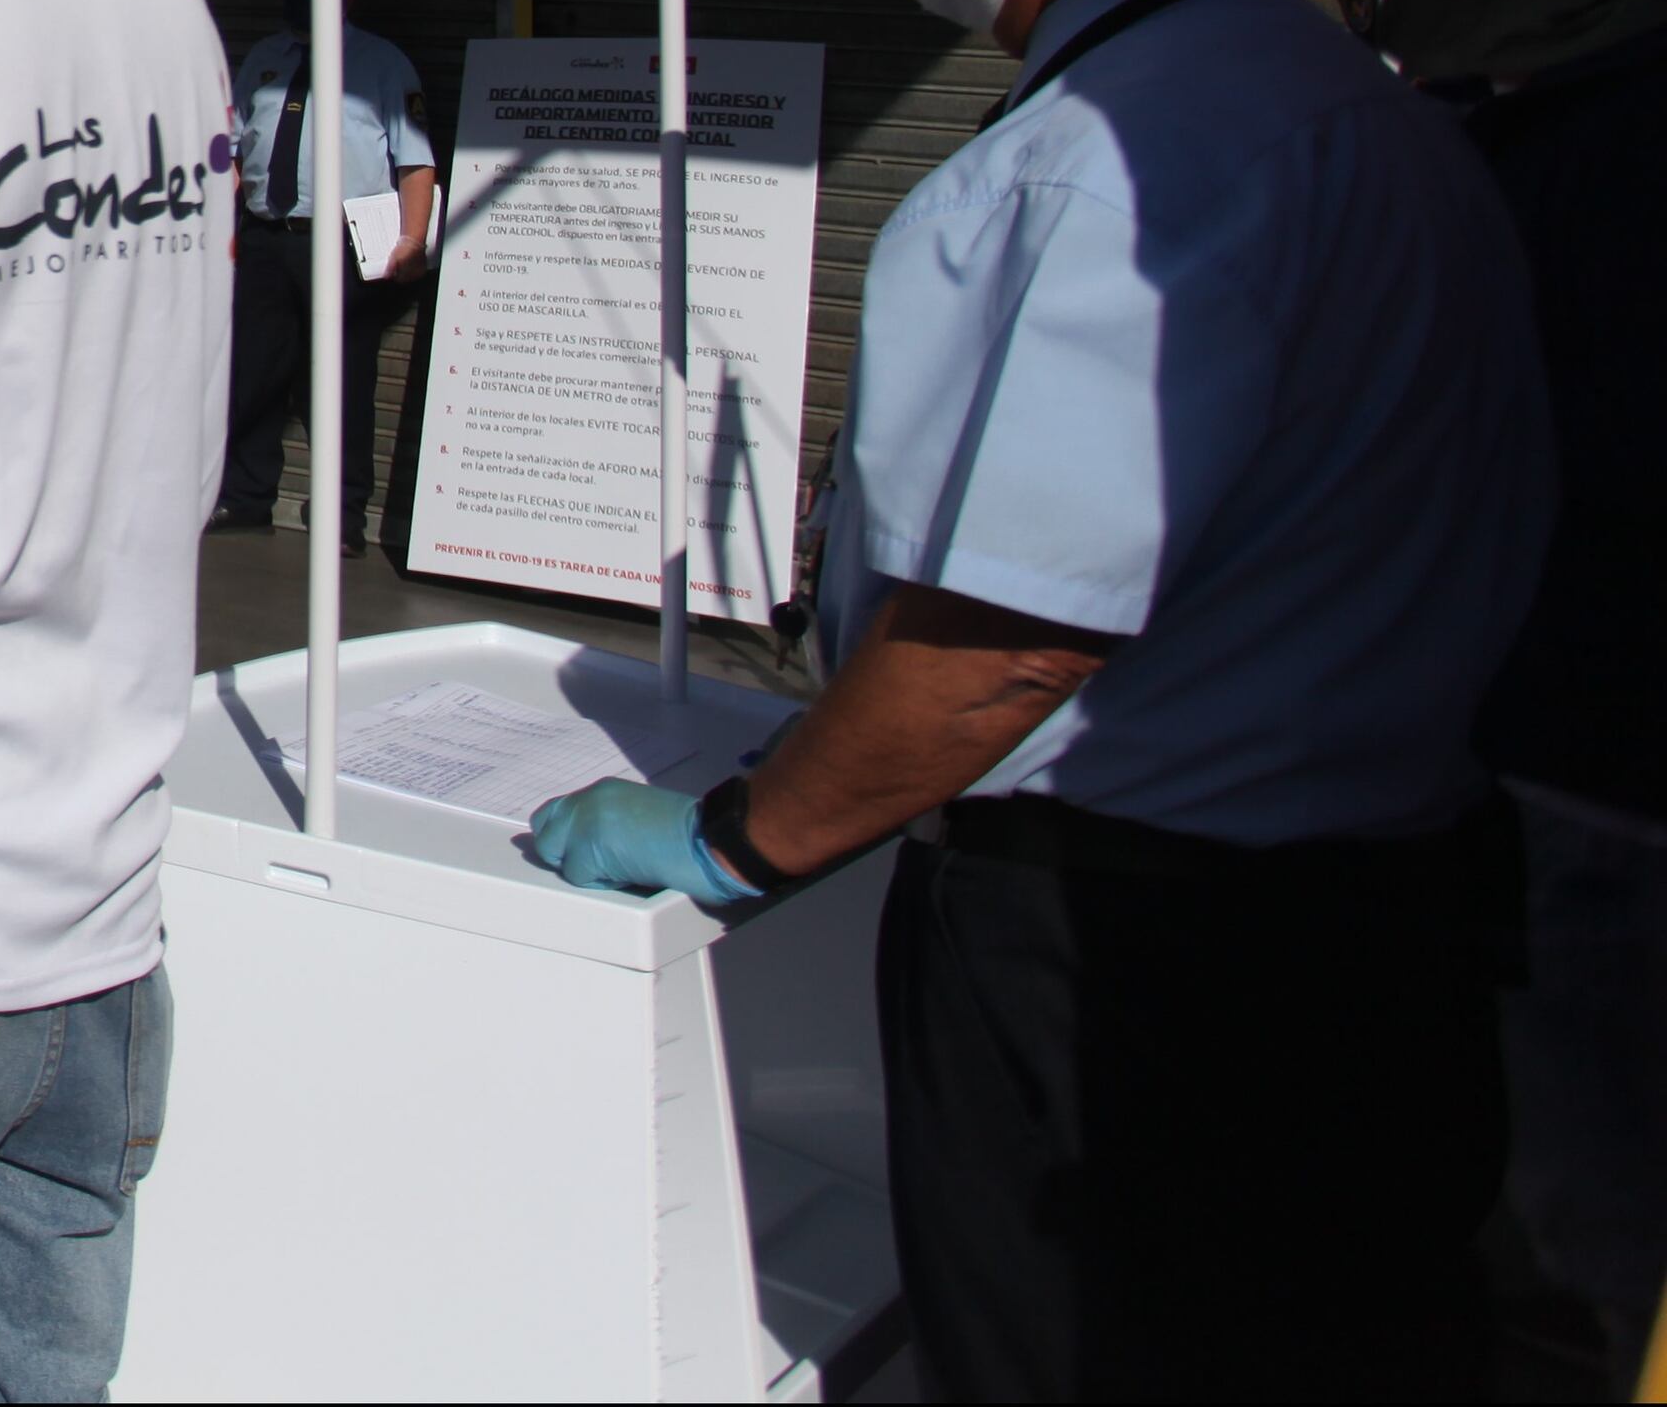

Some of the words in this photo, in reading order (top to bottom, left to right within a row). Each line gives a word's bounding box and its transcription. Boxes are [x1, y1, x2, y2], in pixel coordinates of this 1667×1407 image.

[489, 86, 574, 102] DECÁLOGO
[578, 89, 656, 104] MEDIDAS
[687, 92, 769, 108] INGRESO
[774, 96, 786, 110] Y
[495, 106, 654, 123] COMPORTAMIENTO
[686, 111, 774, 129] INTERIOR
[525, 125, 557, 139] DEL
[560, 126, 627, 141] CENTRO
[539, 180, 580, 188] mayores
[583, 180, 595, 188] de
[598, 181, 610, 189] 70
[563, 167, 576, 175] de
[626, 169, 638, 177] SE
[694, 172, 706, 181] EL
[710, 173, 761, 185] INGRESO
[765, 177, 778, 186] de
[491, 202, 512, 210] Todo
[514, 202, 552, 212] visitante
[554, 204, 577, 212] debe
[686, 211, 721, 221] MEDIR
[723, 213, 738, 223] SU
[488, 226, 507, 235] CON
[558, 230, 603, 241] dispuesto
[619, 233, 633, 242] las
[490, 213, 561, 224] TEMPERATURA
[564, 216, 589, 226] antes
[592, 218, 605, 226] del
[608, 219, 643, 230] ingreso
[699, 226, 721, 235] SUS
[723, 227, 765, 238] MANOS
[156, 232, 207, 255] TODO
[485, 251, 533, 262] Infórmese
[543, 255, 581, 265] respete
[583, 257, 598, 265] las
[601, 258, 651, 270] MEDIDAS
[750, 269, 765, 280] DE
[479, 303, 499, 312] USO
[502, 304, 515, 313] DE
[480, 289, 490, 298] Al
[493, 291, 529, 301] interior
[530, 293, 545, 302] del
[547, 294, 580, 304] centro
[582, 296, 631, 309] comercial
[634, 301, 646, 310] es
[729, 308, 743, 318] EL
[474, 341, 487, 350] de
[489, 342, 536, 355] seguridad
[547, 347, 559, 356] de
[561, 347, 597, 360] locales
[476, 328, 496, 338] Siga
[507, 330, 552, 342] RESPETE
[556, 334, 576, 344] LAS
[695, 346, 759, 363] PERSONAL
[471, 366, 481, 376] El
[483, 368, 526, 380] visitante
[528, 372, 552, 382] debe
[555, 374, 598, 387] procurar
[600, 378, 652, 393] mantener
[470, 380, 478, 390] la
[481, 381, 535, 394] DISTANCIA
[538, 387, 551, 396] DE
[555, 387, 569, 397] UN
[573, 390, 612, 403] METRO
[615, 394, 628, 405] de
[631, 397, 658, 408] otras
[465, 422, 477, 431] no
[467, 406, 477, 416] Al
[479, 408, 515, 420] interior
[517, 411, 529, 421] de
[532, 413, 546, 424] los
[549, 415, 584, 428] locales
[588, 419, 618, 431] EVITE
[622, 422, 660, 436] TOCAR
[462, 447, 502, 461] Respete
[516, 452, 579, 470] señalización
[582, 460, 595, 470] de
[597, 462, 637, 476] AFORO
[693, 475, 749, 491] dispuesto
[486, 463, 525, 477] entrada
[527, 468, 539, 478] de
[542, 470, 566, 482] cada
[456, 501, 468, 511] de
[470, 503, 494, 515] cada
[495, 506, 528, 519] pasillo
[531, 510, 547, 521] del
[549, 513, 583, 526] centro
[458, 486, 498, 502] Respete
[500, 491, 515, 503] las
[517, 494, 565, 510] FLECHAS
[568, 500, 591, 513] QUE
[594, 504, 641, 520] INDICAN
[644, 510, 657, 522] EL
[435, 543, 483, 558] PREVENIR
[486, 549, 496, 561] EL
[499, 551, 542, 567] COVID-19
[545, 558, 557, 569] ES
[560, 561, 594, 575] TAREA
[597, 566, 610, 577] DE
[613, 568, 641, 583] CADA
[689, 580, 752, 600] NOSOTROS
